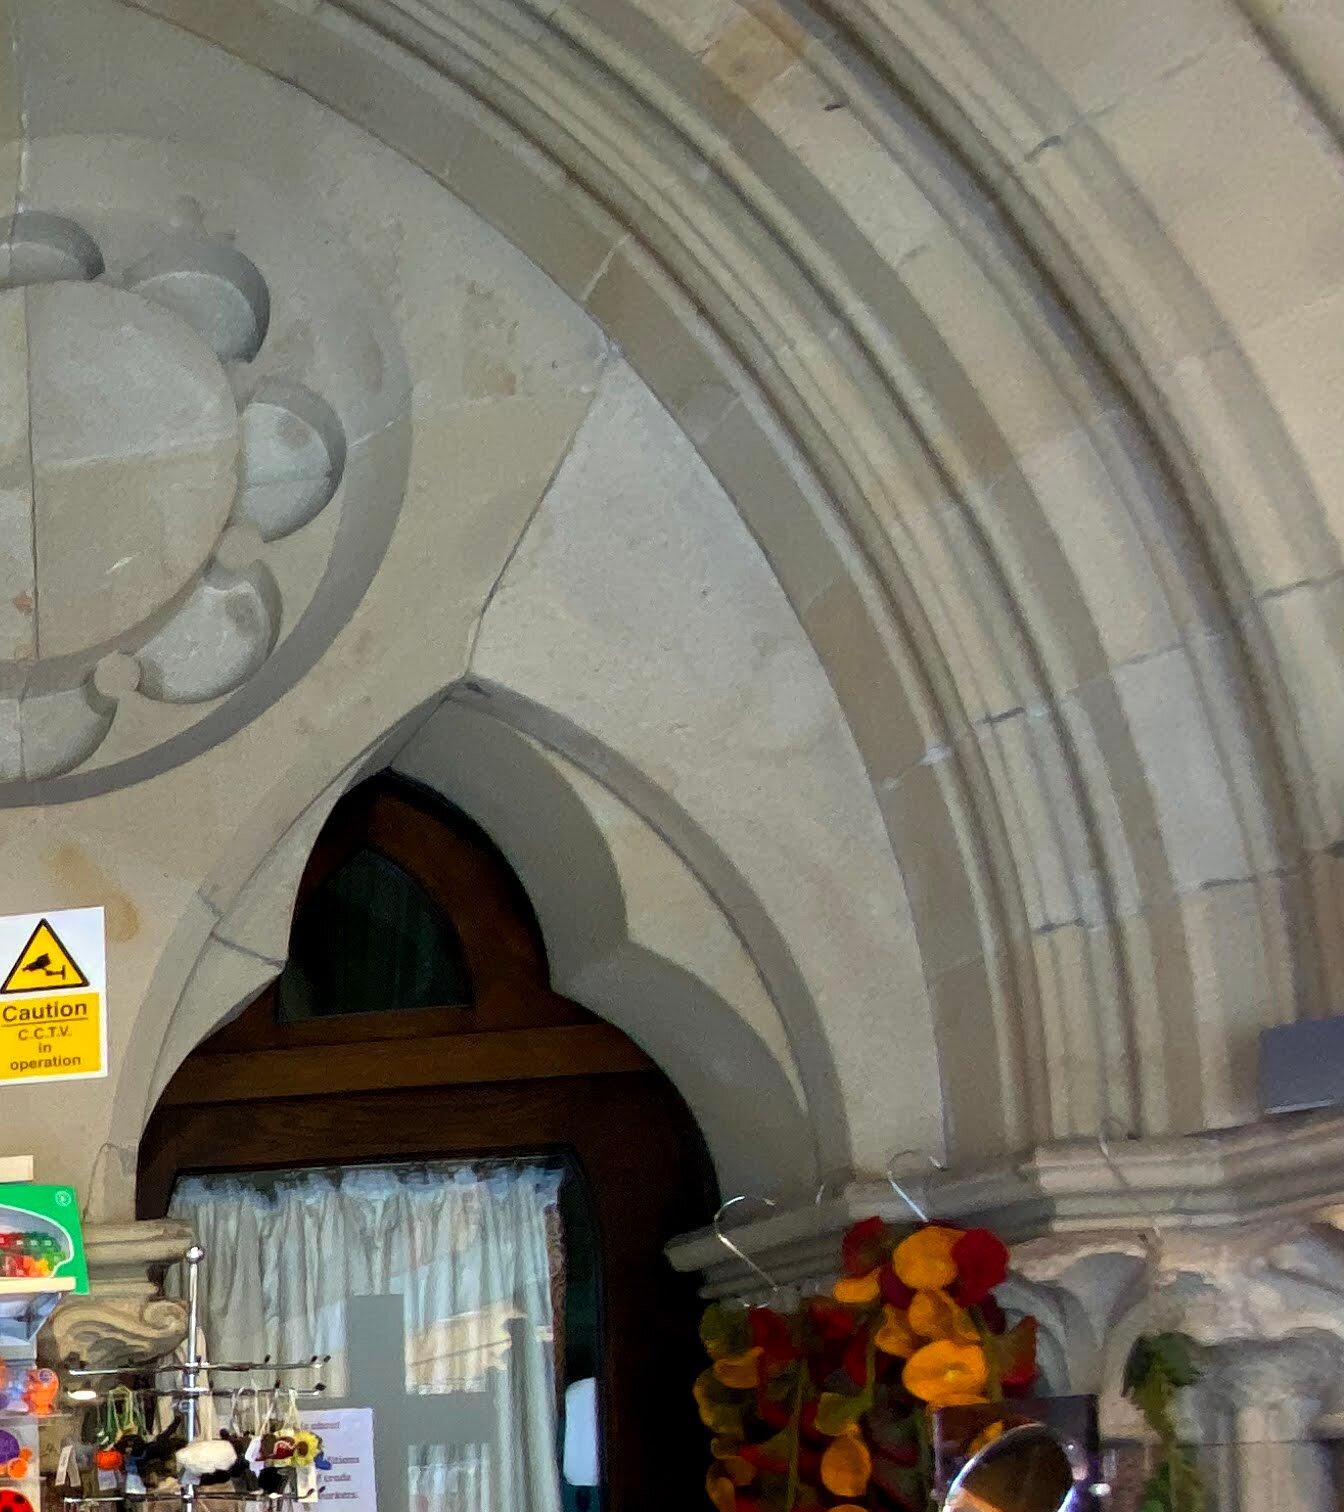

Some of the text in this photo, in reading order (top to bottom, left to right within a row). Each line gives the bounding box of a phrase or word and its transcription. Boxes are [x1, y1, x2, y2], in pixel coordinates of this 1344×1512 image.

[2, 1001, 87, 1022] Caution
[38, 1042, 52, 1053] in
[10, 1055, 81, 1072] operation
